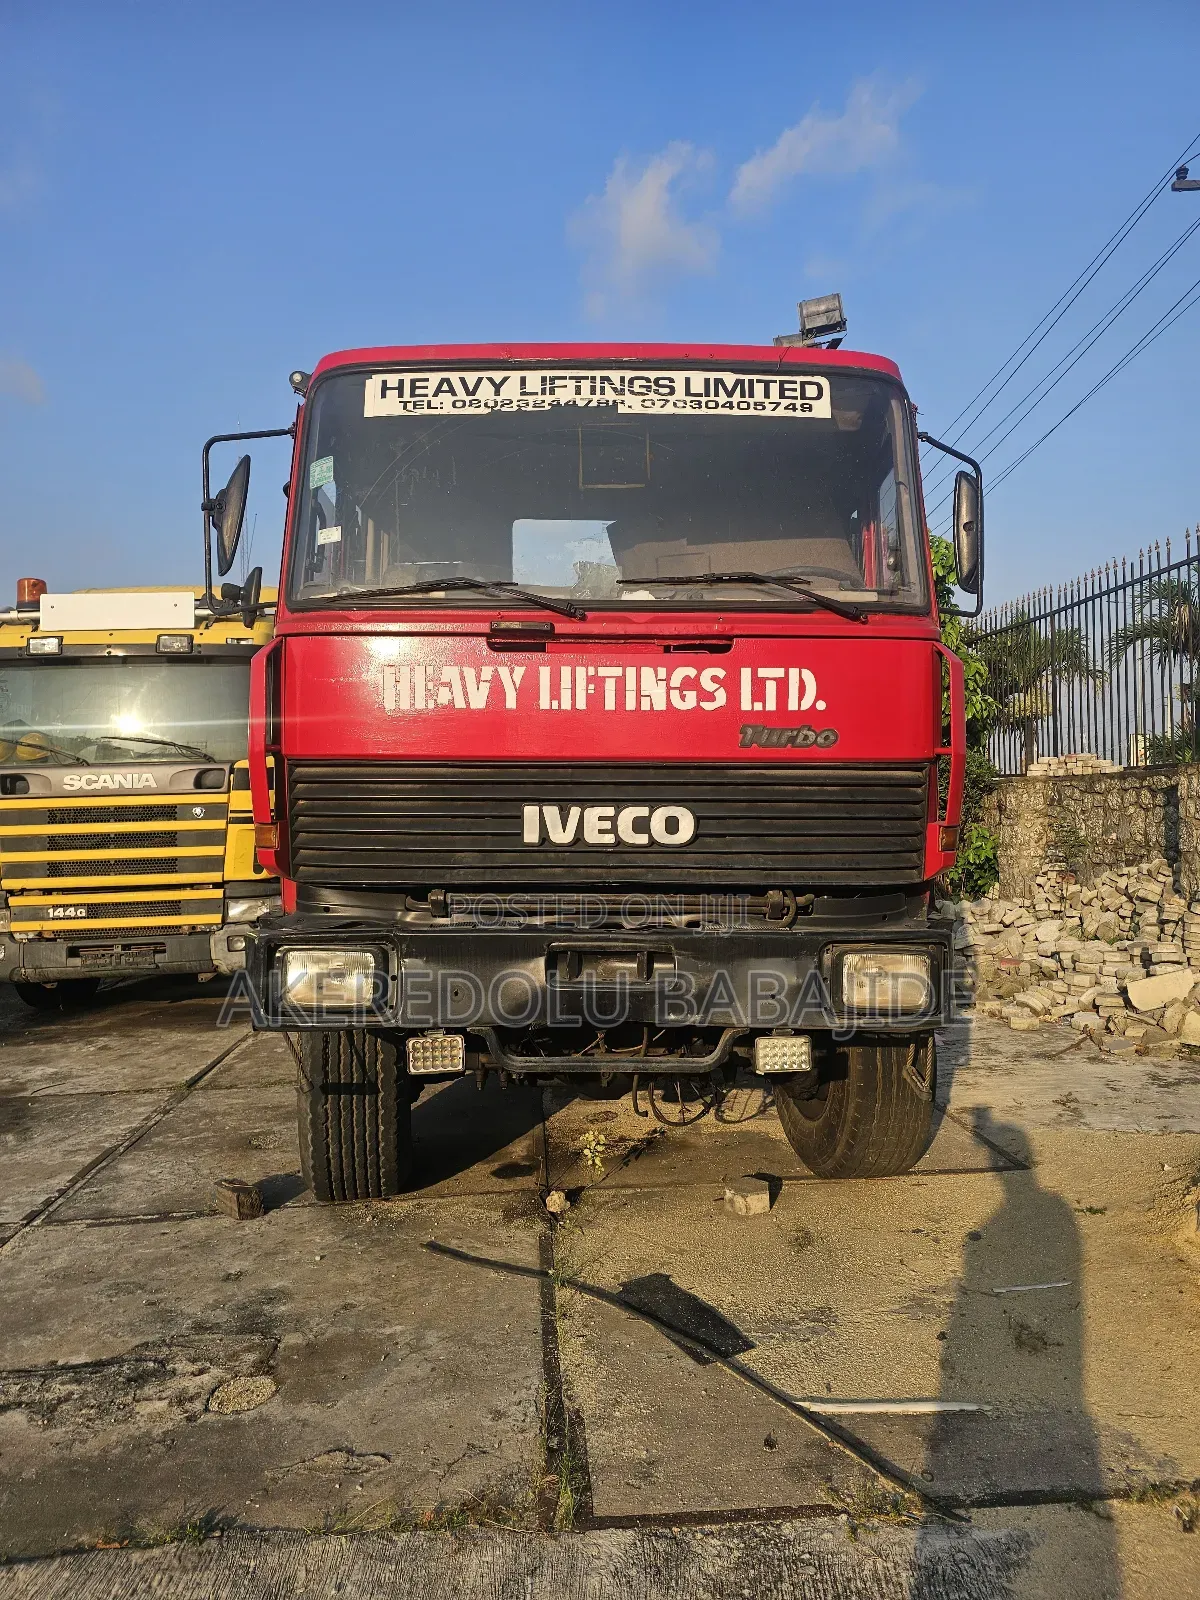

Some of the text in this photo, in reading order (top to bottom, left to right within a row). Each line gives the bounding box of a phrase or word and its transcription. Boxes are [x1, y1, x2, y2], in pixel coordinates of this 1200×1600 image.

[380, 375, 824, 401] HEAVY LIFTINGS LIMITED
[398, 400, 444, 410] TEL:
[383, 665, 827, 711] HEAVY LIFTINGS LTD.
[739, 724, 839, 748] Turbo
[63, 773, 157, 790] SCANIA
[523, 804, 696, 846] IVECO
[48, 907, 86, 918] 144G
